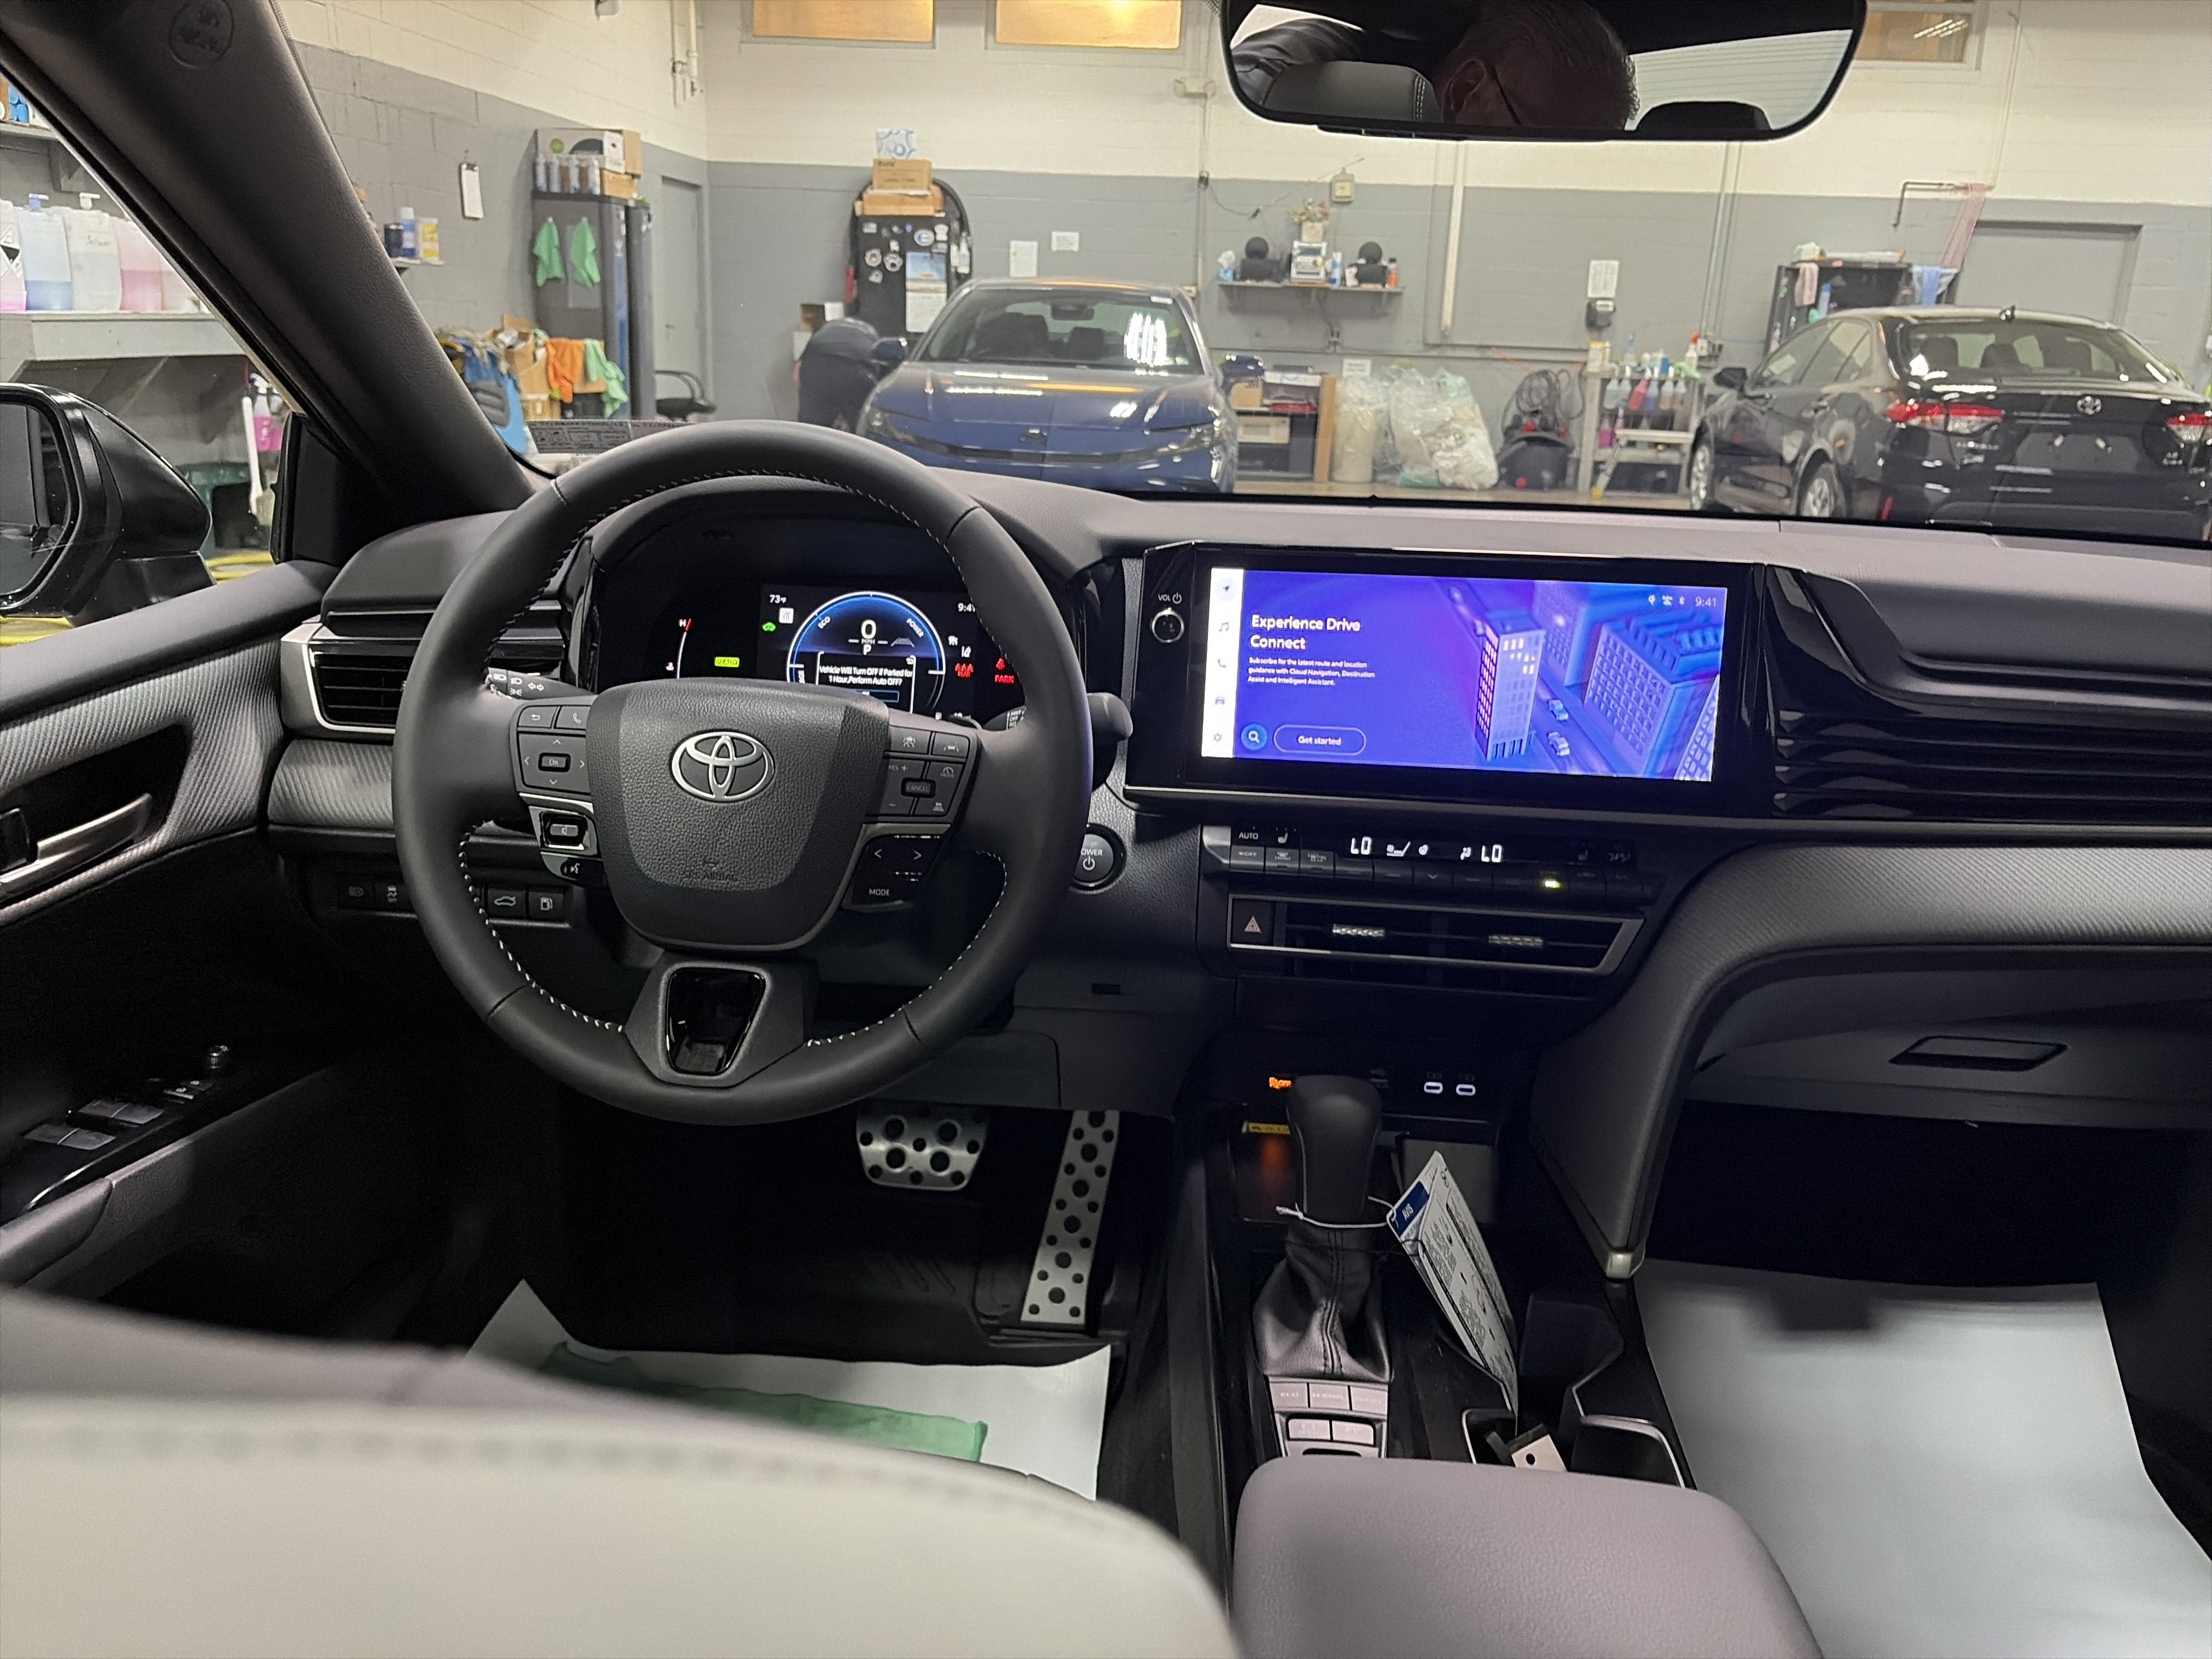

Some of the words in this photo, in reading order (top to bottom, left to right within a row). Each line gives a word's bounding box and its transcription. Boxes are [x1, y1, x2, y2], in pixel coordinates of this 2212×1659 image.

[1695, 596, 1717, 607] 9:41
[818, 616, 831, 629] ECO
[906, 618, 924, 638] POWER
[1251, 614, 1324, 631] Experience
[1326, 618, 1361, 631] Drive
[861, 619, 876, 639] 0
[1250, 635, 1306, 650] Connect
[863, 644, 872, 656] P
[820, 665, 840, 674] Vehicle
[867, 668, 879, 676] OFF
[884, 669, 904, 677] Parked
[905, 669, 913, 678] for
[887, 678, 902, 686] OFF?
[995, 674, 1014, 684] PARK
[1298, 735, 1313, 744] Get
[1314, 736, 1341, 746] started
[907, 785, 928, 793] CANCEL
[1238, 832, 1259, 840] AUTO
[868, 888, 890, 896] MODE
